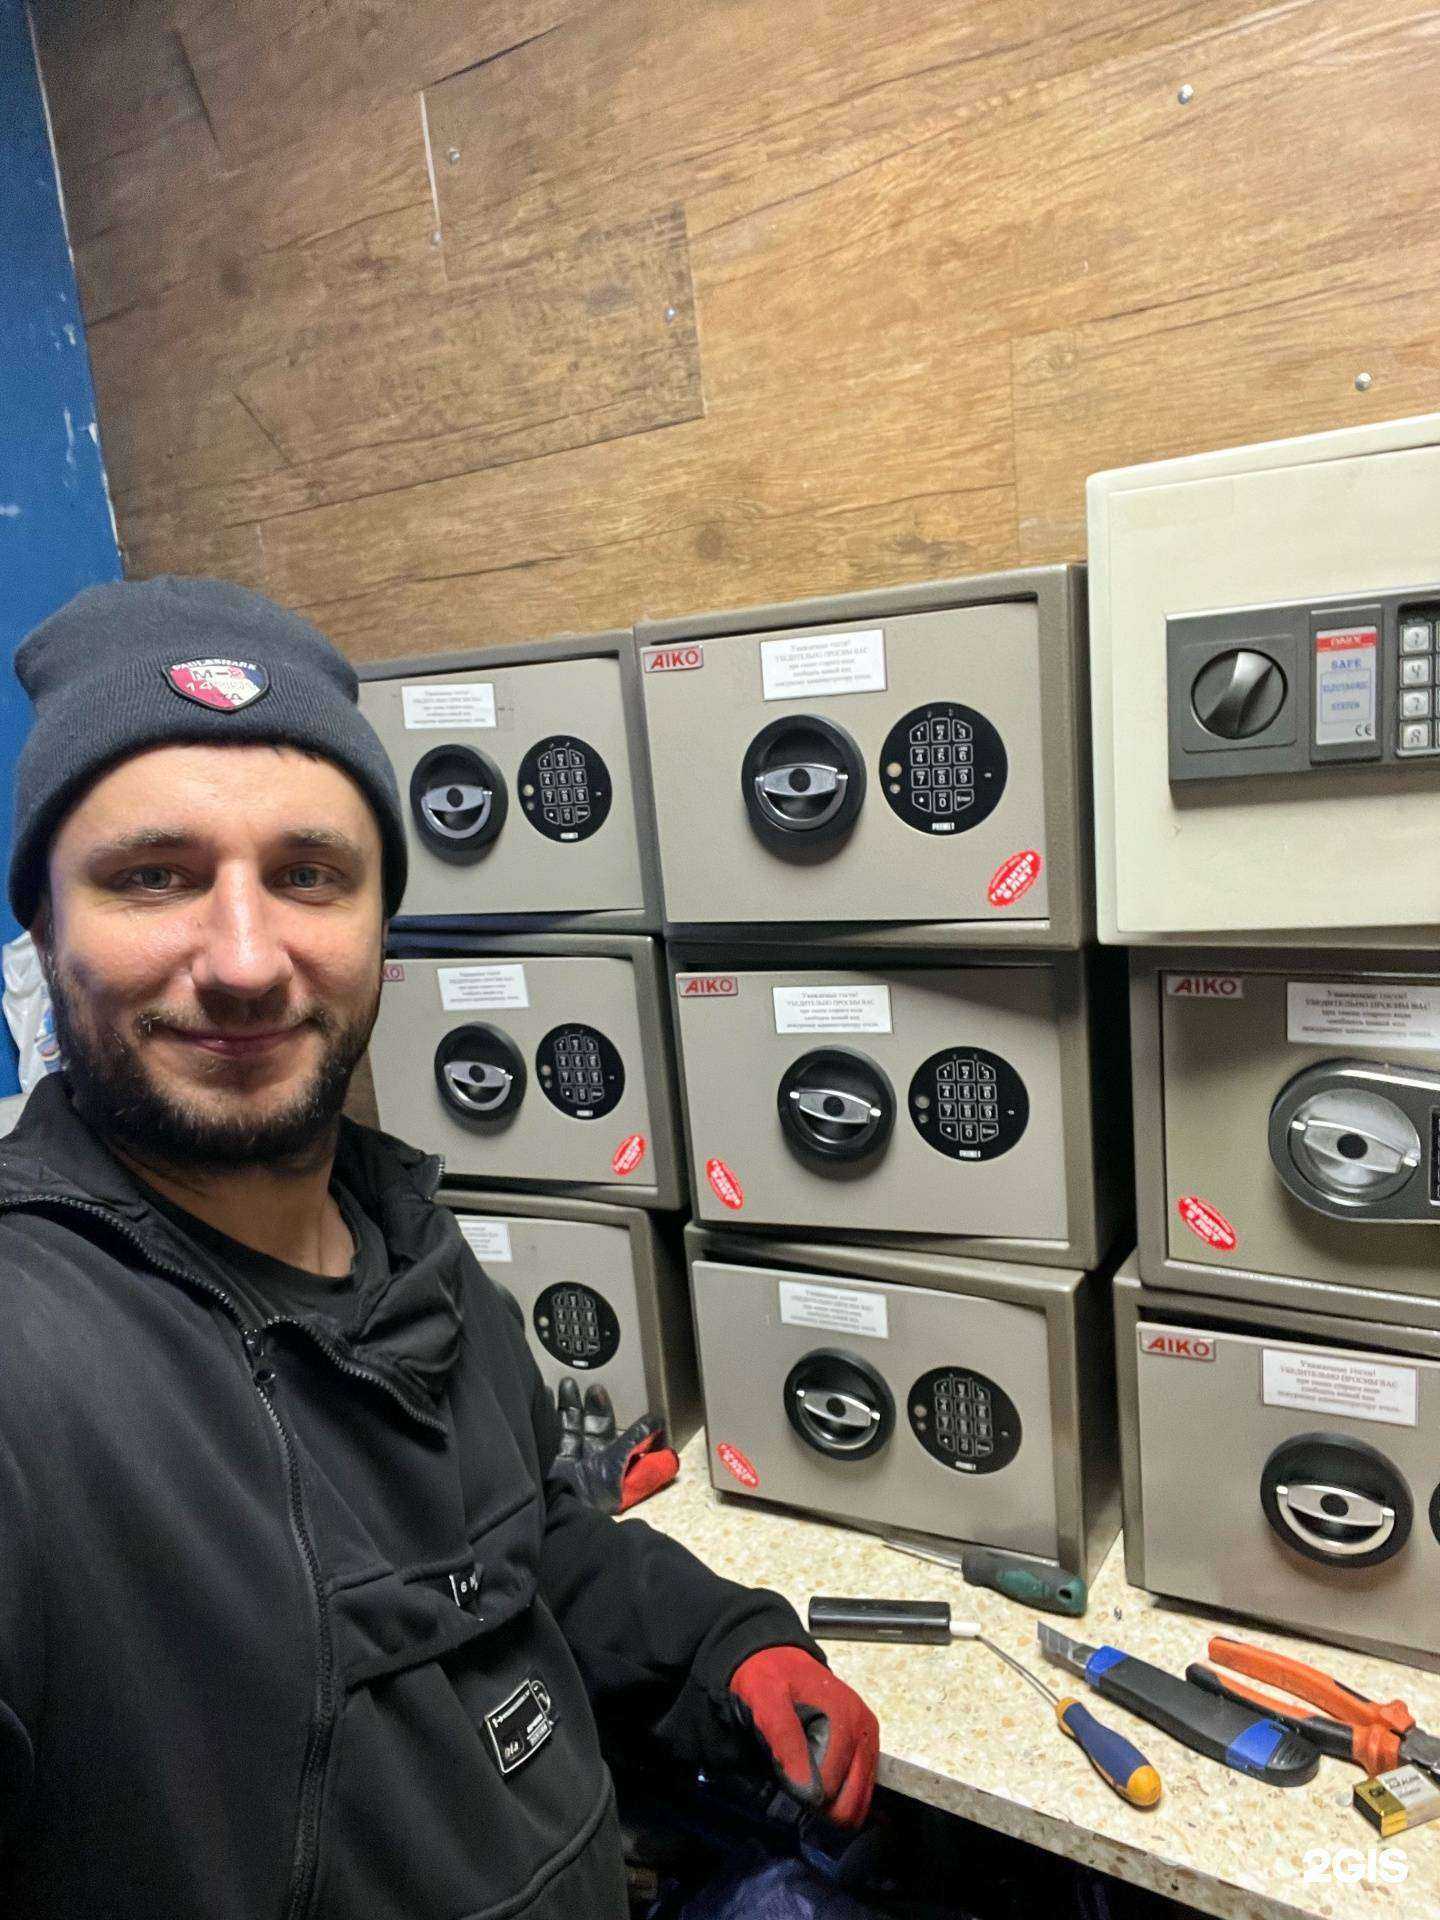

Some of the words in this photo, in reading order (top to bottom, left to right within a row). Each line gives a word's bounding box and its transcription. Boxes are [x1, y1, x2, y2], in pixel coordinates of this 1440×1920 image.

[651, 650, 699, 669] AIKO
[1331, 659, 1362, 670] SAFE
[685, 979, 733, 993] AIKO
[1174, 978, 1237, 996] AIKO
[1147, 1335, 1210, 1358] AIKO
